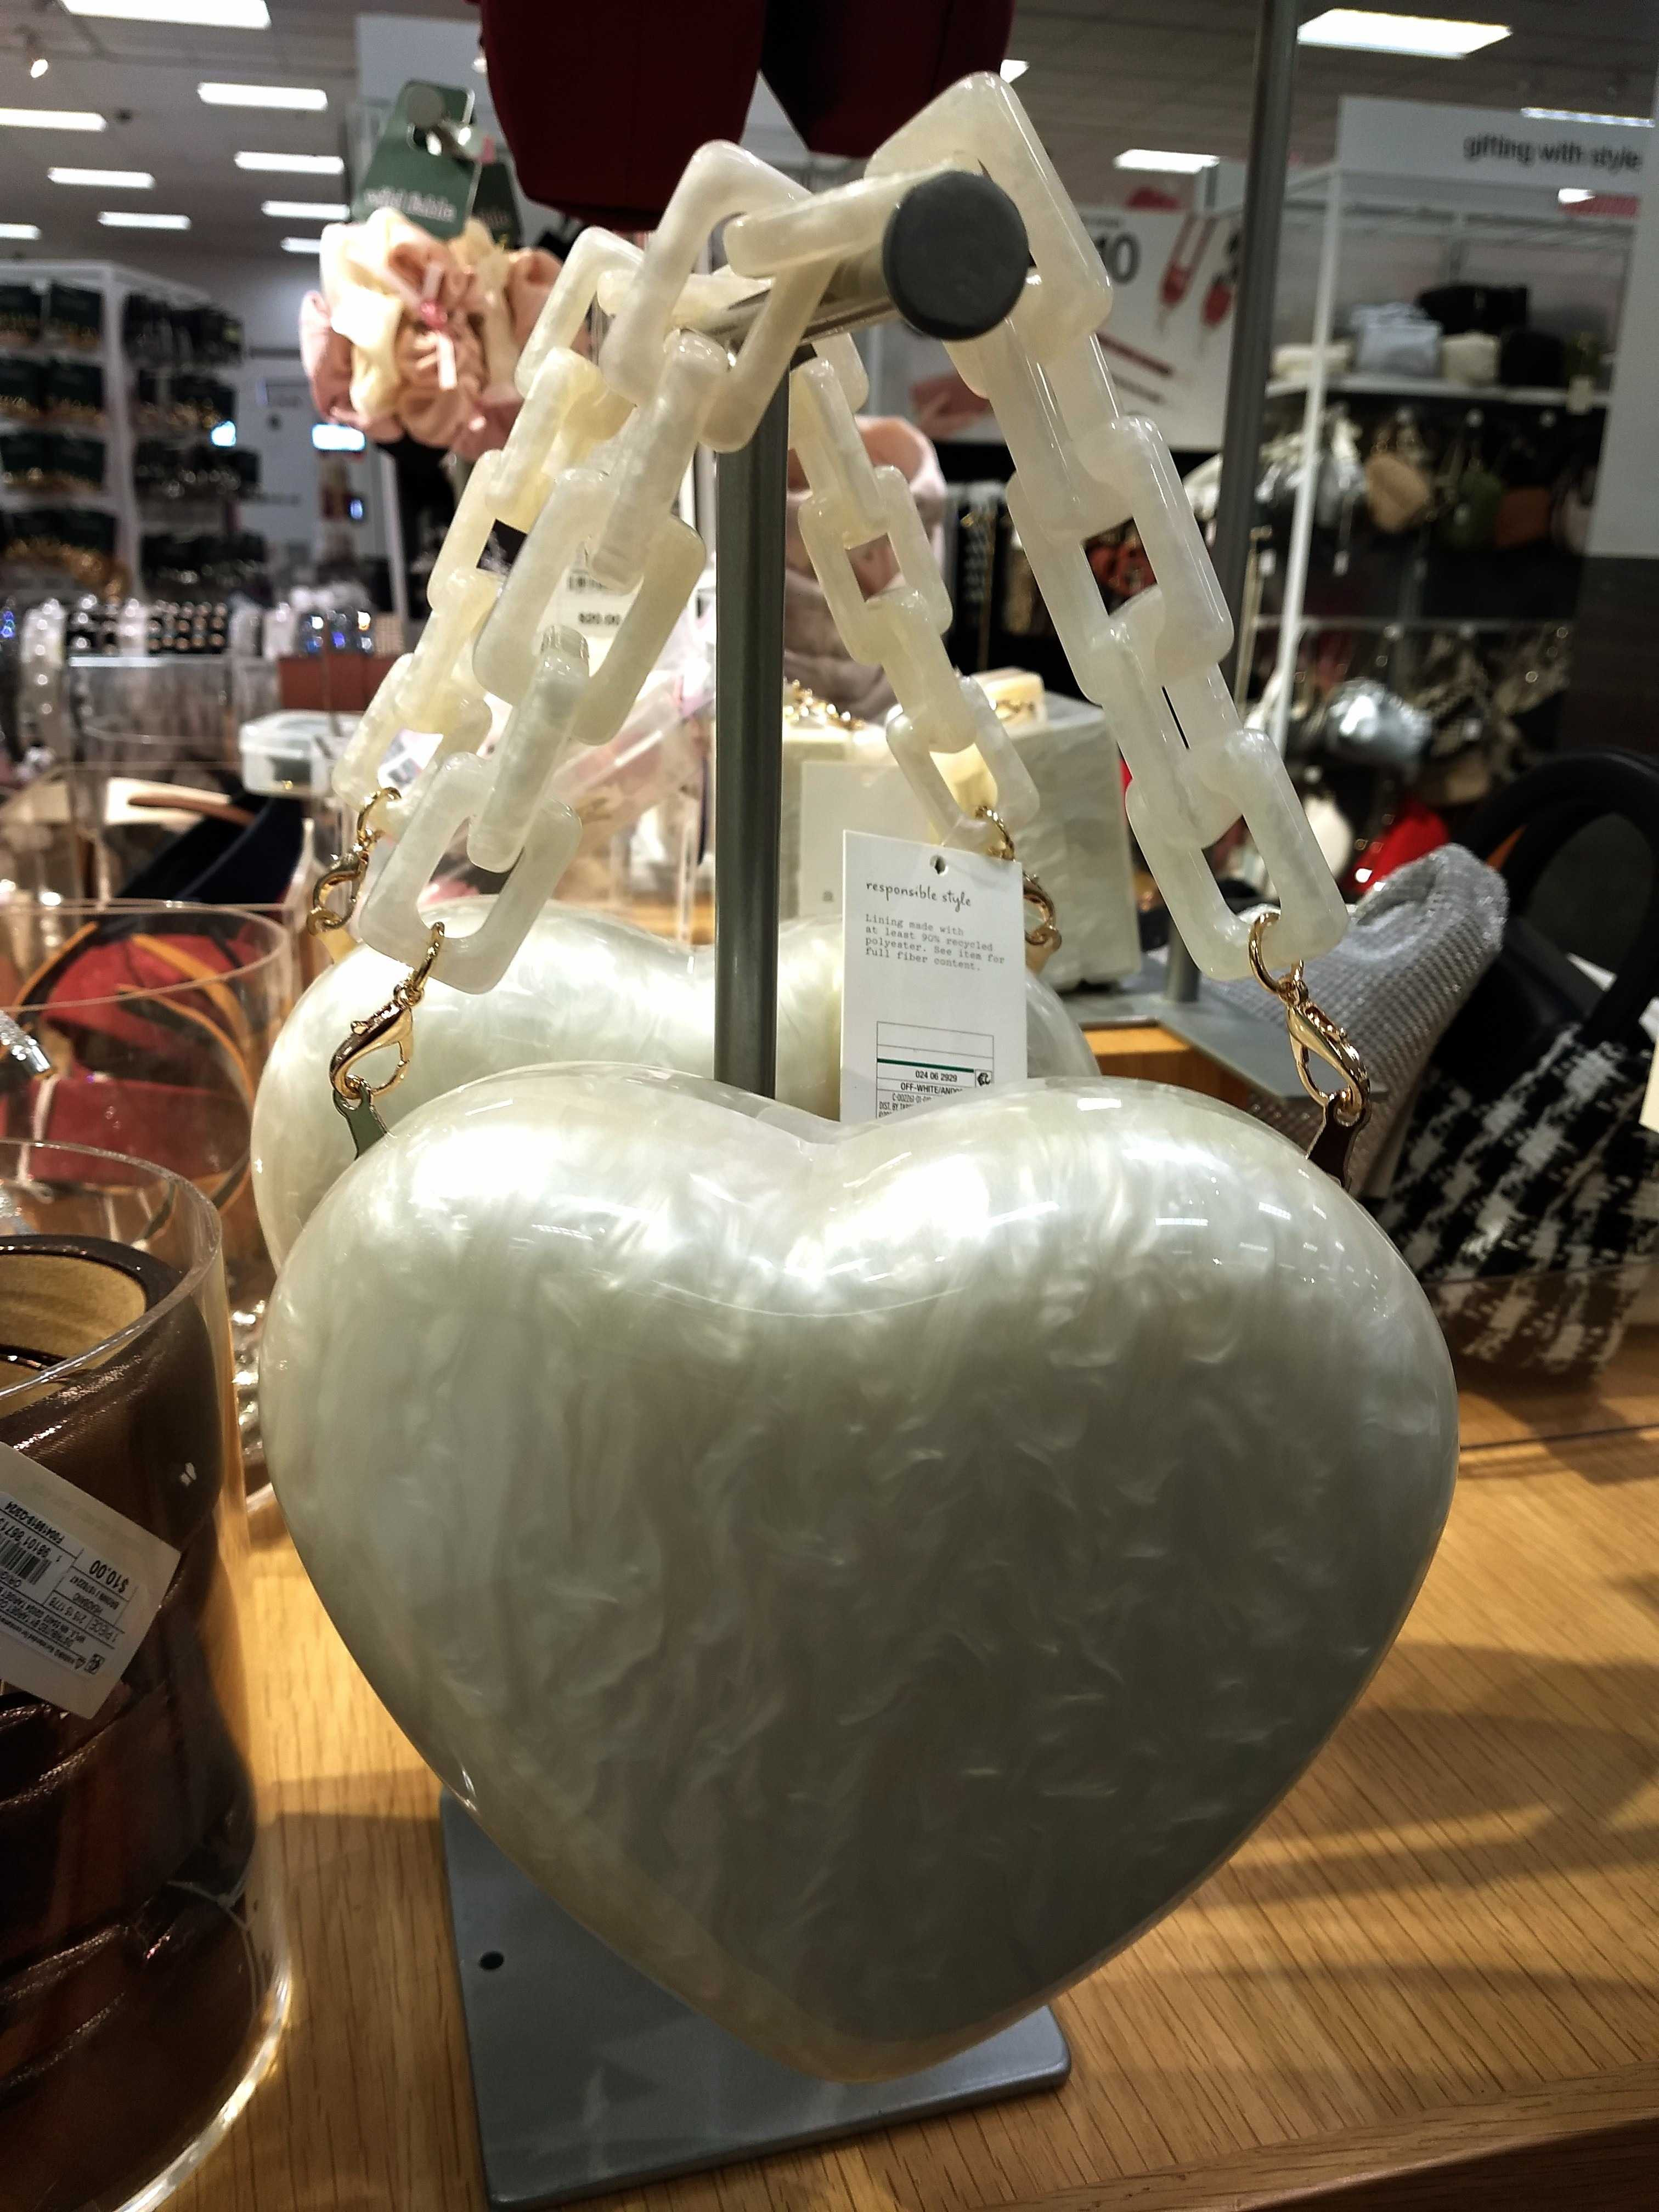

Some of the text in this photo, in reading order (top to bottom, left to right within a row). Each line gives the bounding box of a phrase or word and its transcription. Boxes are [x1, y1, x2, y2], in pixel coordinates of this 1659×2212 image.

[1463, 133, 1641, 174] gifting with style
[866, 882, 971, 912] responsible style
[866, 913, 964, 936] Lining made with
[866, 926, 994, 952] at least 90% recycled
[866, 937, 1006, 964] polyester. See item for
[866, 947, 981, 972] full fiber content.
[916, 1070, 958, 1082] 024 06 2929
[87, 1558, 131, 1594] $10.00
